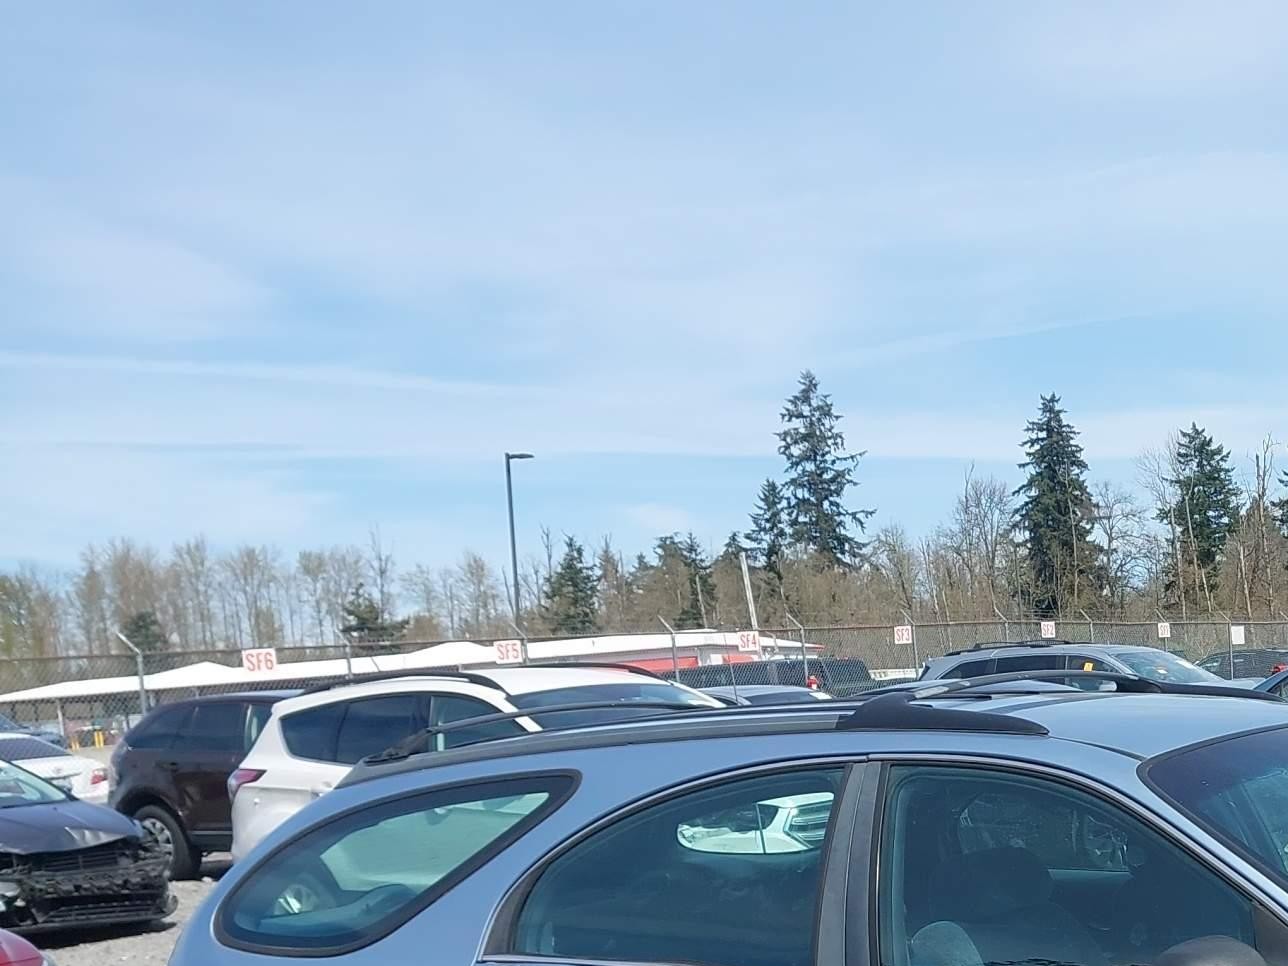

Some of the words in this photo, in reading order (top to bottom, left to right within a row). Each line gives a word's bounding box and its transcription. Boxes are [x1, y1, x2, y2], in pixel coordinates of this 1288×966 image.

[740, 633, 757, 649] SF4
[896, 628, 910, 641] SF3
[496, 643, 519, 660] SF5
[246, 652, 274, 671] SF6
